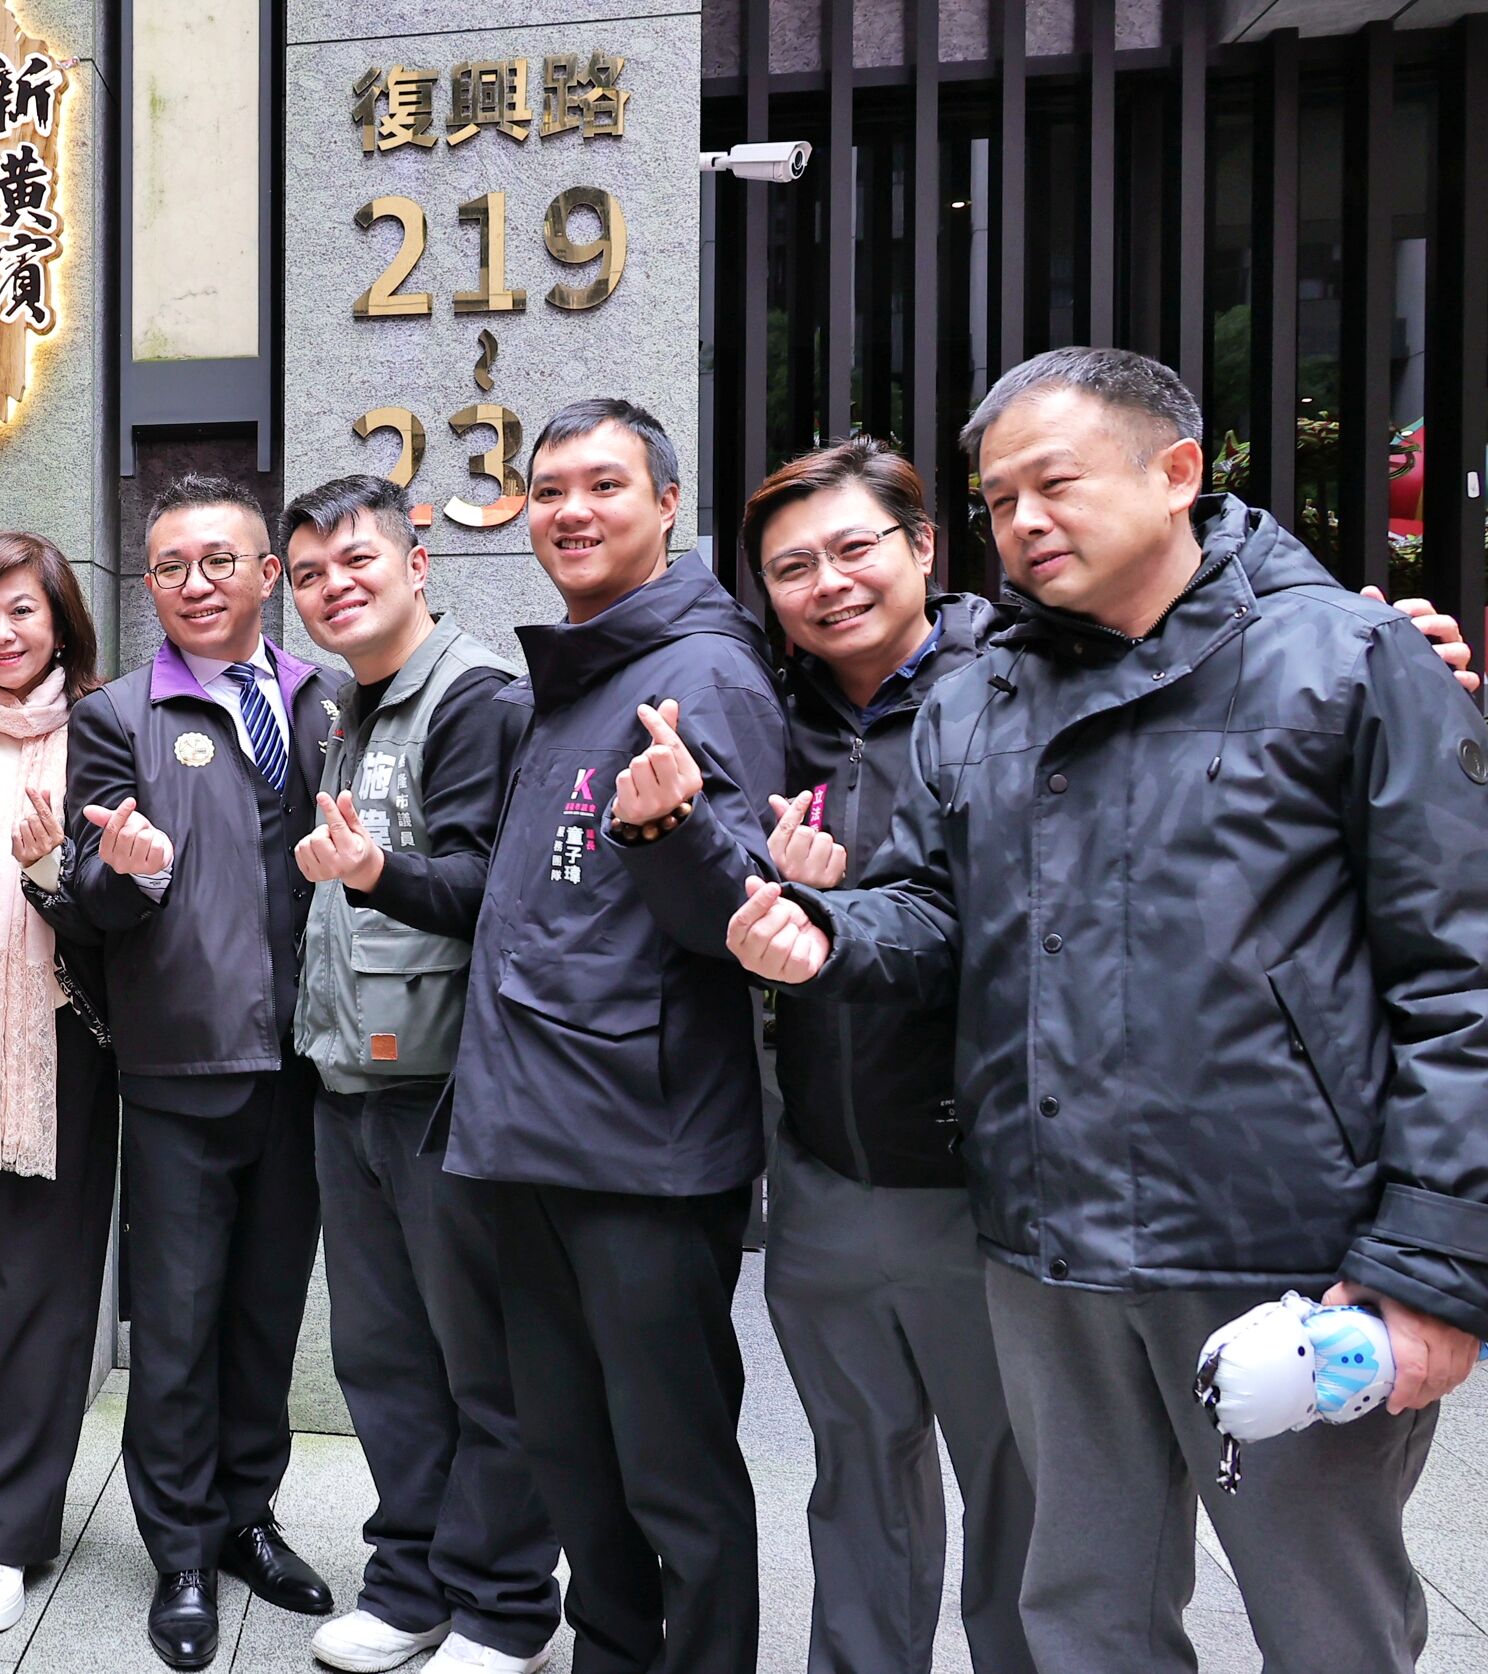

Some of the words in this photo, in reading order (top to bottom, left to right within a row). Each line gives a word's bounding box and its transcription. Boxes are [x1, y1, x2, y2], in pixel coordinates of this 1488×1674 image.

[353, 50, 631, 153] 復興路
[353, 185, 628, 318] 219
[563, 825, 585, 884] 童子瑋
